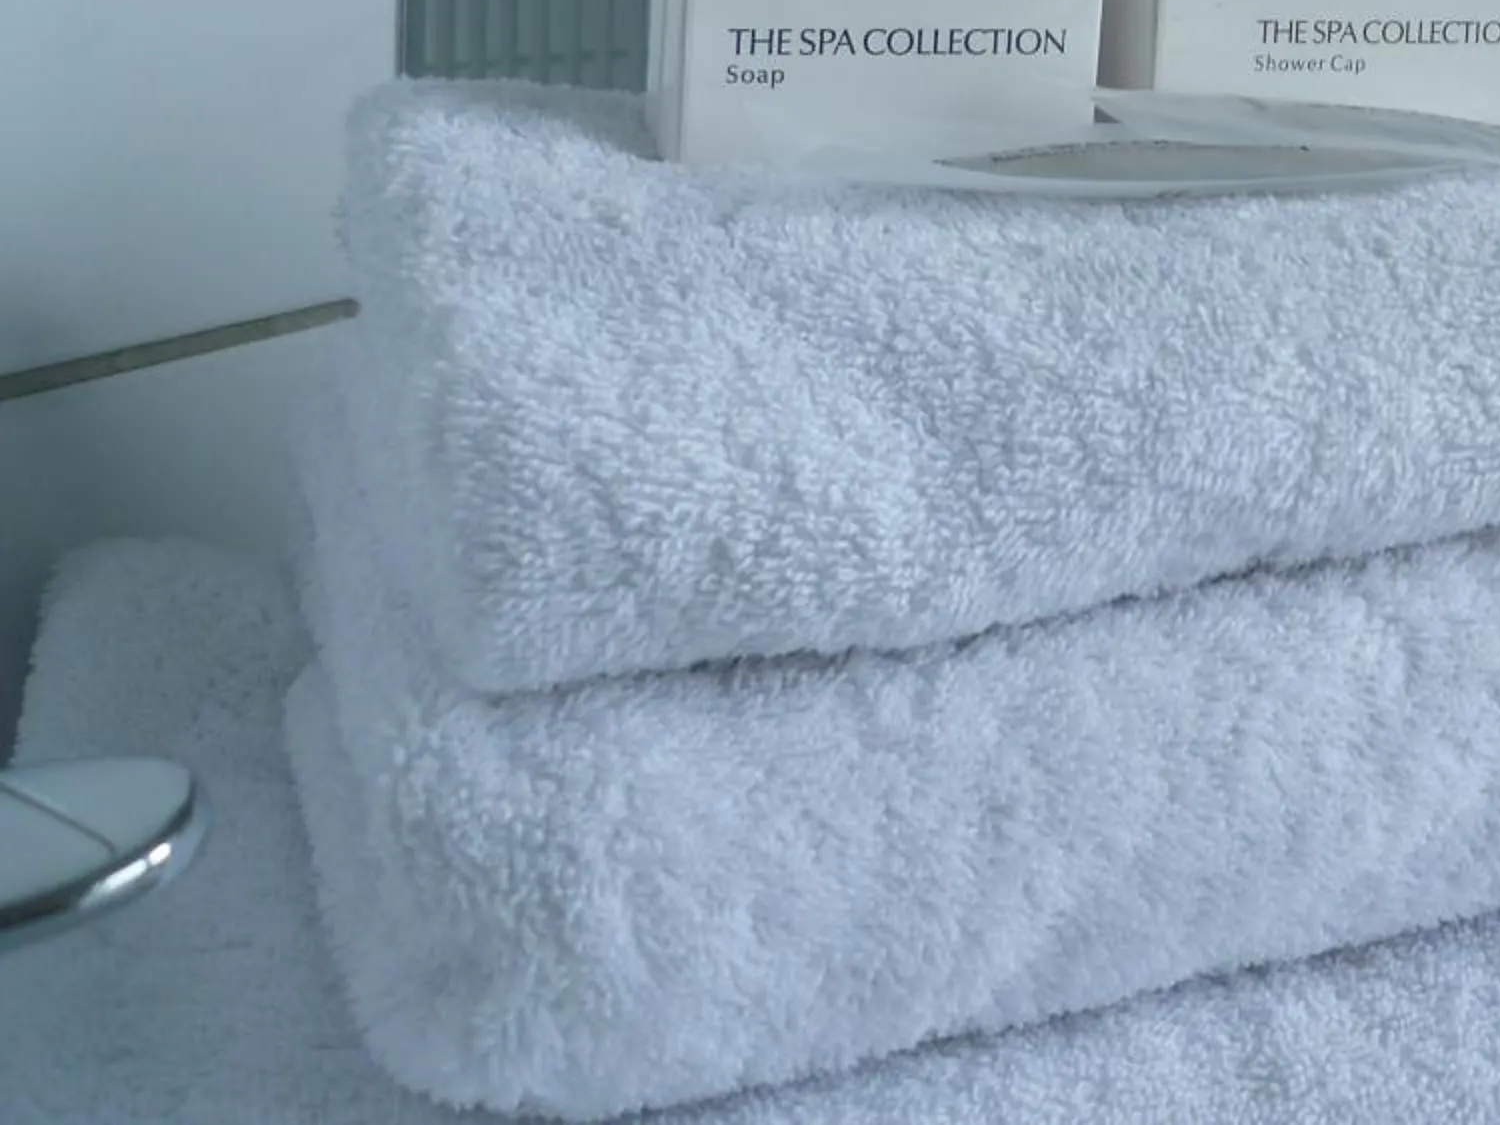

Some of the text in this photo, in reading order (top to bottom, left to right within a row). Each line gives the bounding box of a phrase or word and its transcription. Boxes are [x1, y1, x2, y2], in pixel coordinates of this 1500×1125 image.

[728, 28, 1067, 56] THE SPA COLLECTION
[1257, 19, 1309, 44] THE
[1313, 20, 1358, 44] SPA
[726, 64, 785, 89] Soap
[1254, 54, 1366, 75] Shower Cap
